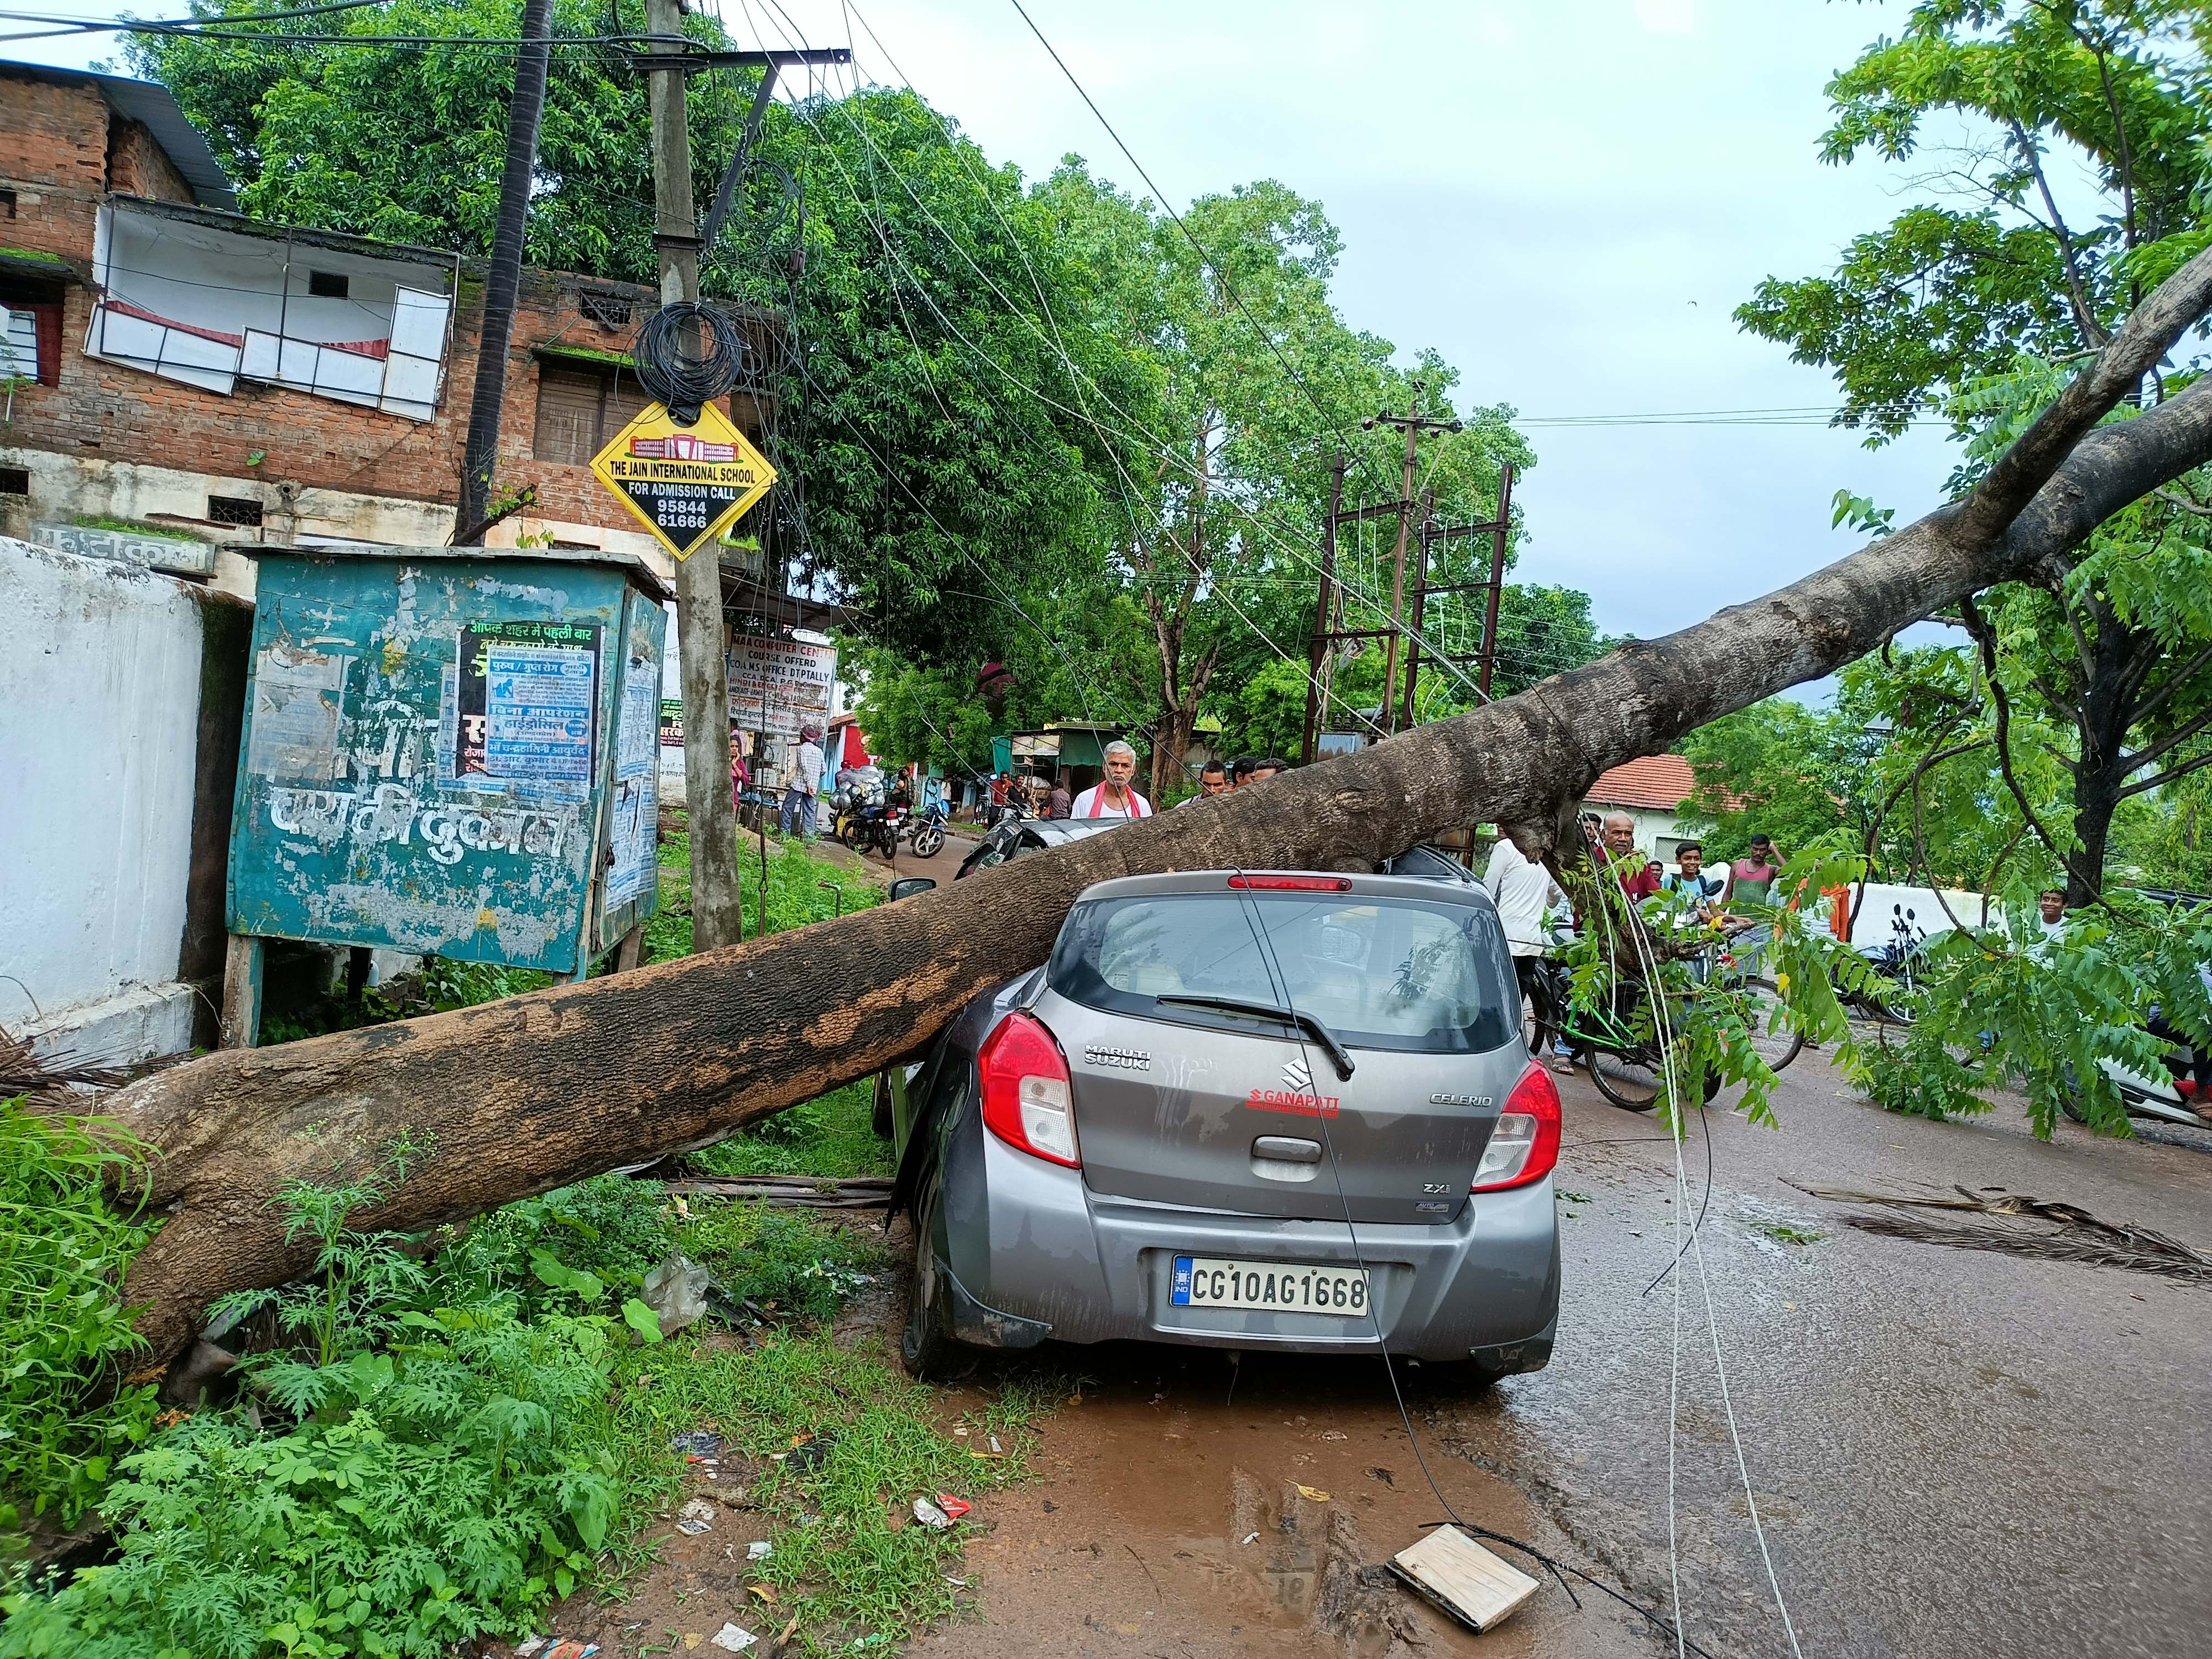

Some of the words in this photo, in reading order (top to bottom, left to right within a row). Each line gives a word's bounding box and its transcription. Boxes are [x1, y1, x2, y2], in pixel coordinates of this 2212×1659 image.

[610, 460, 627, 476] THE
[629, 462, 647, 477] JAIN
[650, 463, 718, 482] INTERNATIONAL
[721, 468, 755, 484] SCHOOL
[628, 482, 649, 495] FOR
[651, 483, 708, 498] ADMISSION
[710, 487, 735, 500] CALL
[657, 499, 707, 515] 95844
[658, 514, 707, 529] 61666
[575, 627, 593, 641] बार
[733, 635, 753, 648] MAA
[748, 650, 781, 663] COURSE
[785, 656, 816, 667] OFFERD
[491, 705, 523, 716] बिना
[1085, 1045, 1151, 1060] MARUTI
[1084, 1053, 1151, 1071] SUZUKI
[1264, 1090, 1339, 1109] GANAPATI
[1430, 1093, 1493, 1107] CELERIO
[1193, 1269, 1365, 1308] CG10AG1668
